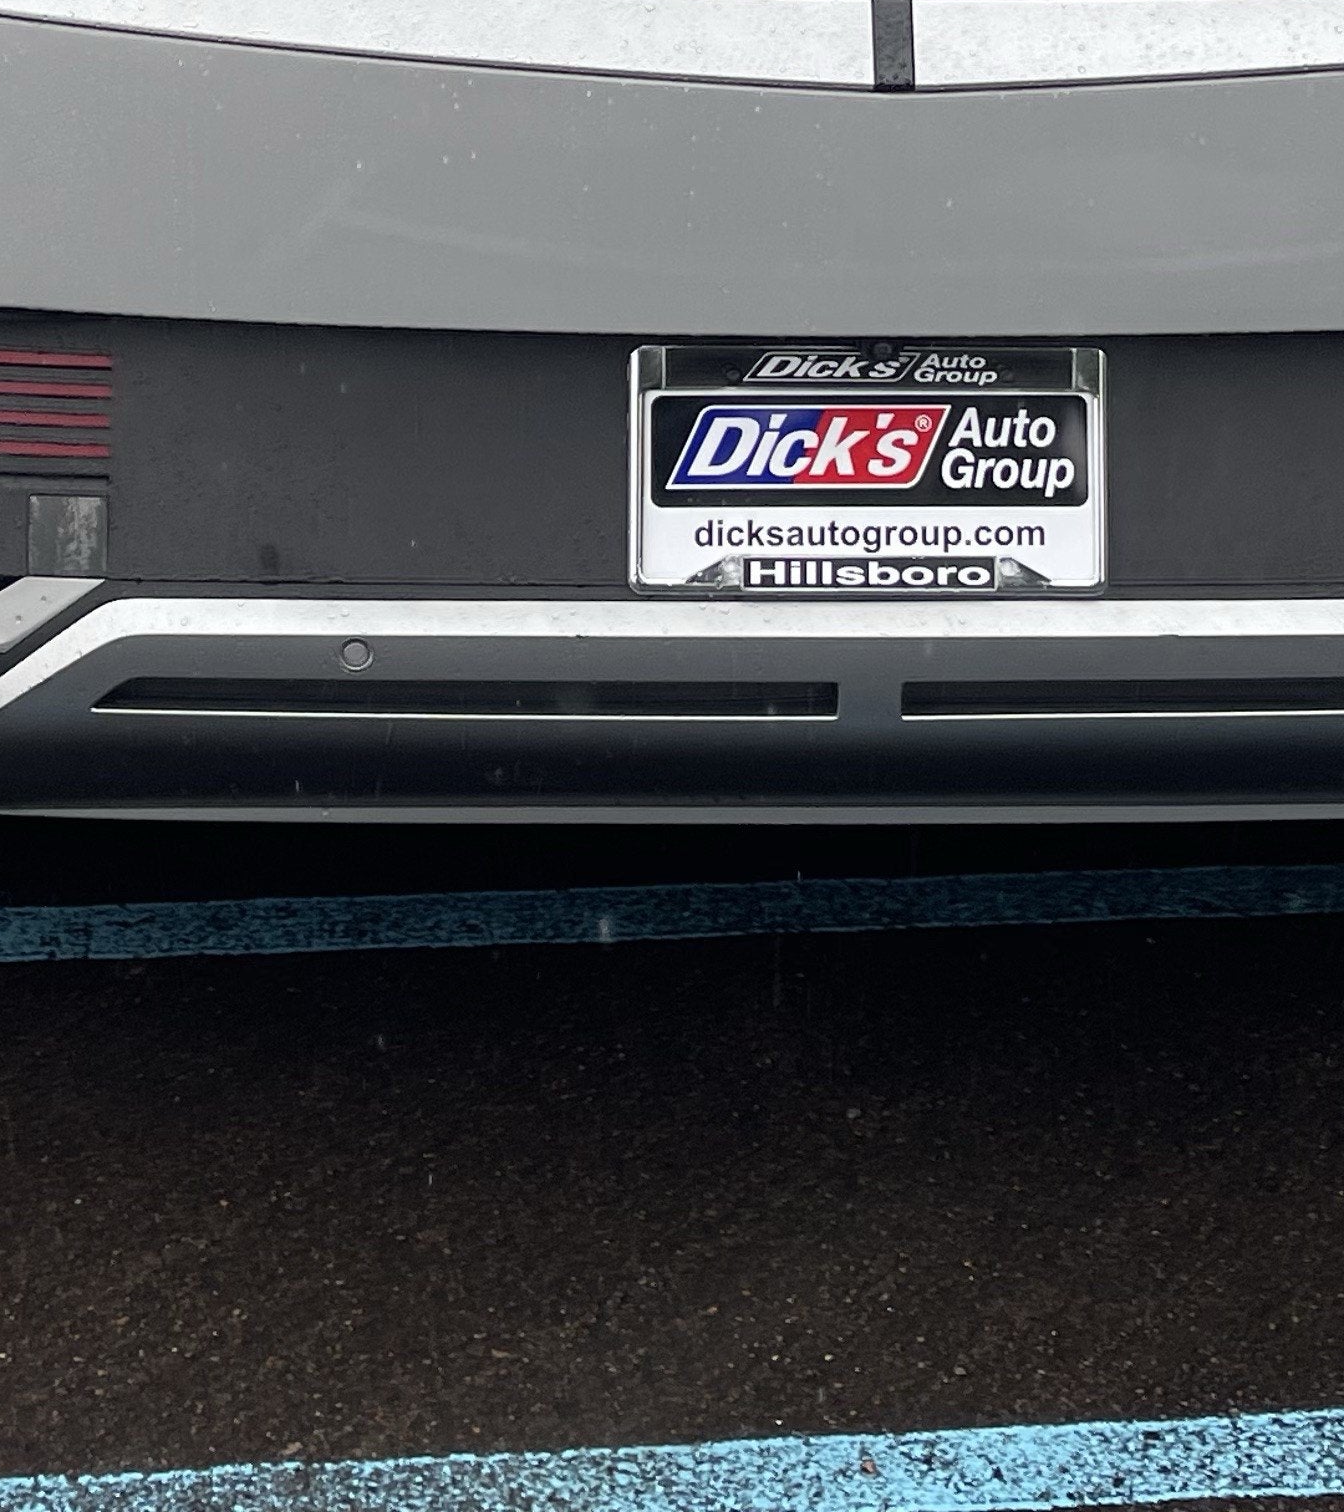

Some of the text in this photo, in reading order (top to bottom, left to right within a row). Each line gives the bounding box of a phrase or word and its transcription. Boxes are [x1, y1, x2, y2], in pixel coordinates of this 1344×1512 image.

[757, 355, 902, 378] Dicks
[920, 353, 986, 369] Auto
[913, 367, 998, 386] Group
[949, 407, 1057, 448] Auto
[687, 413, 919, 478] Dick's
[941, 448, 1076, 498] Group
[694, 519, 1046, 552] dicksautogroup.com
[749, 559, 992, 587] Hillsboro
